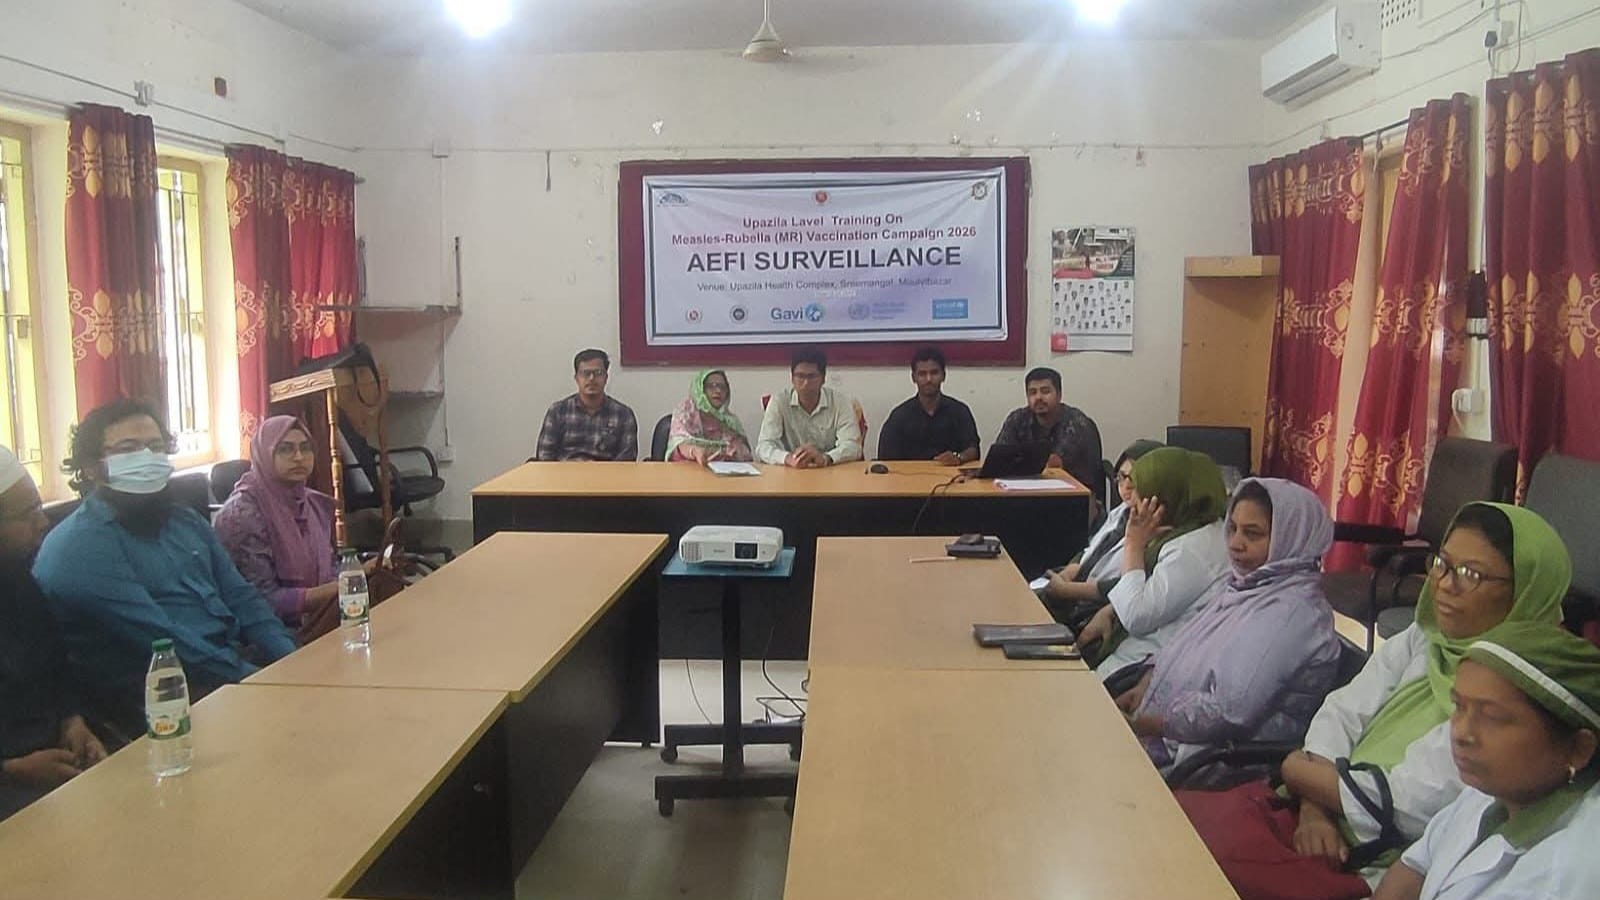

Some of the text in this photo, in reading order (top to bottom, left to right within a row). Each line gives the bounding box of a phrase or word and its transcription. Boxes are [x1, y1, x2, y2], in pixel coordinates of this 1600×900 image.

[743, 213, 903, 230] Upazila Lavel Training On
[672, 226, 977, 245] Measles-Rubella (MR) Vaccination Campaign 2026
[687, 246, 962, 272] AEFI SURVEILLANCE
[765, 280, 793, 290] Health
[770, 307, 803, 320] Gavi
